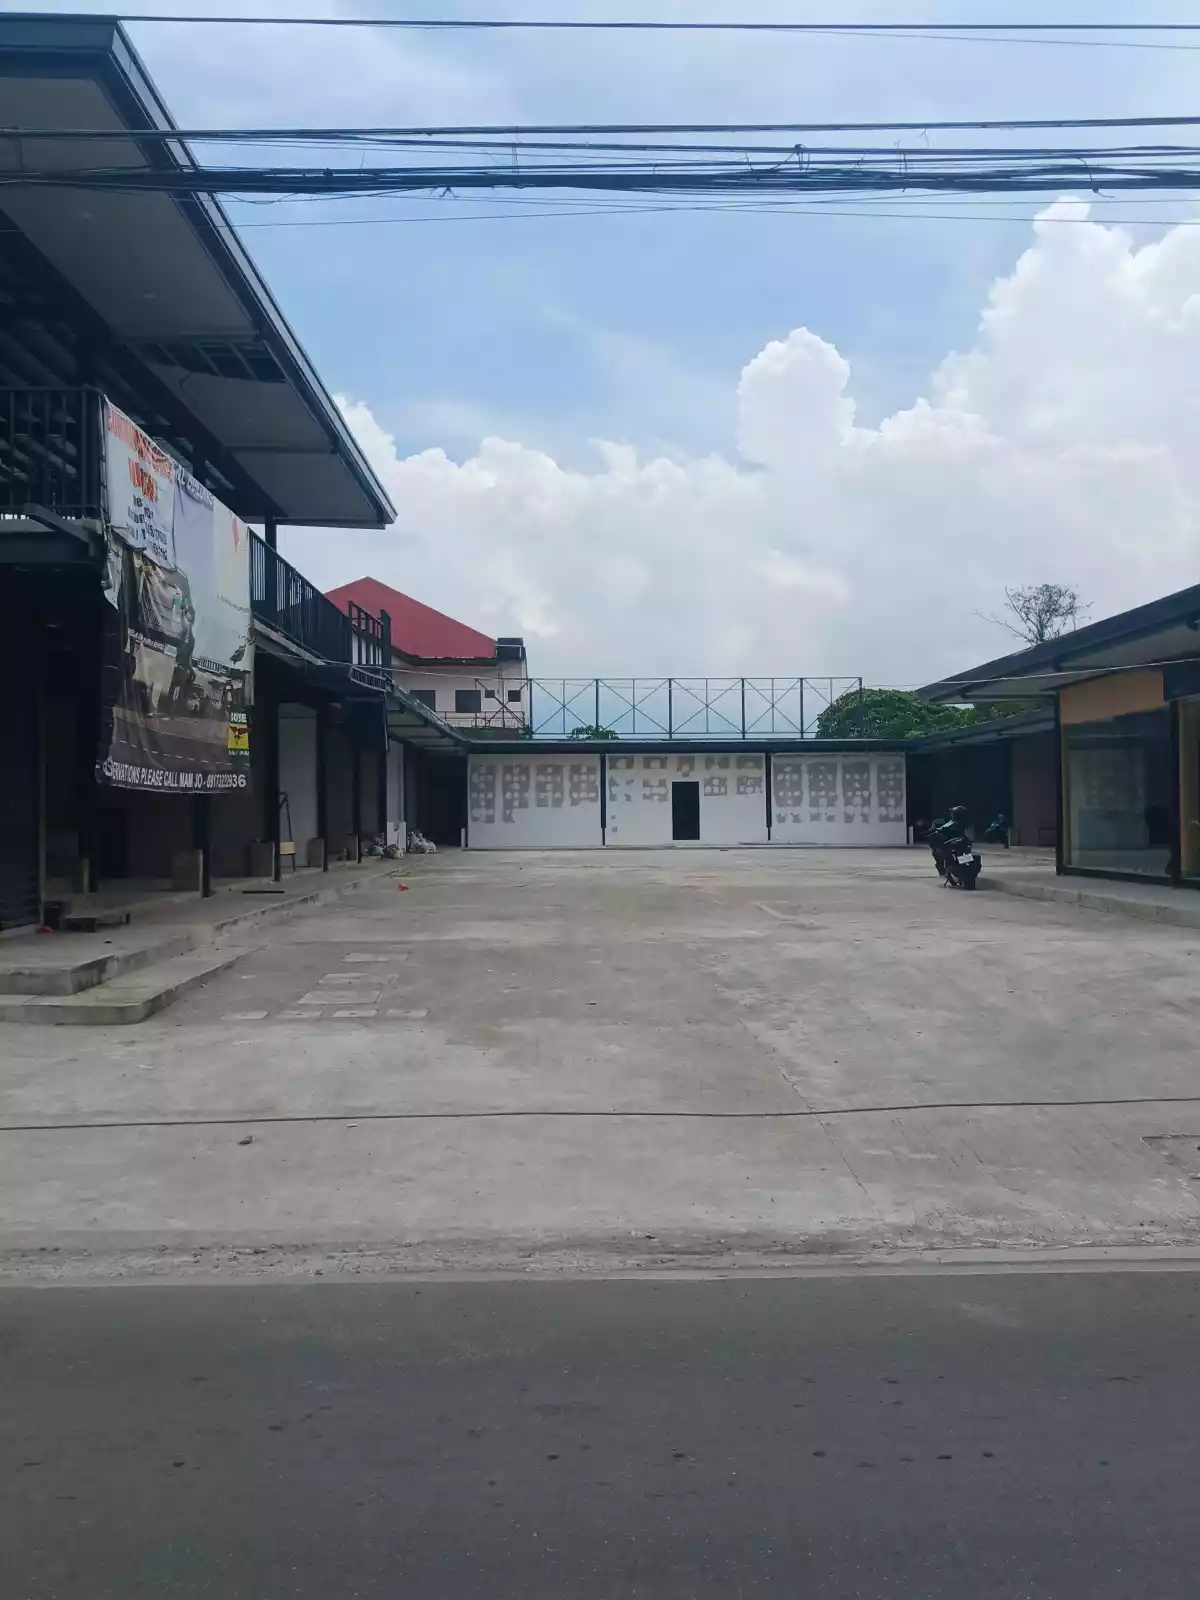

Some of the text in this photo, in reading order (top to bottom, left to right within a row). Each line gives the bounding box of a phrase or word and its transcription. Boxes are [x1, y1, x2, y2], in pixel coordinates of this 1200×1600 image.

[140, 767, 163, 786] PLEASE
[163, 770, 178, 787] CALL
[179, 772, 193, 788] MAM
[194, 772, 203, 788] JO
